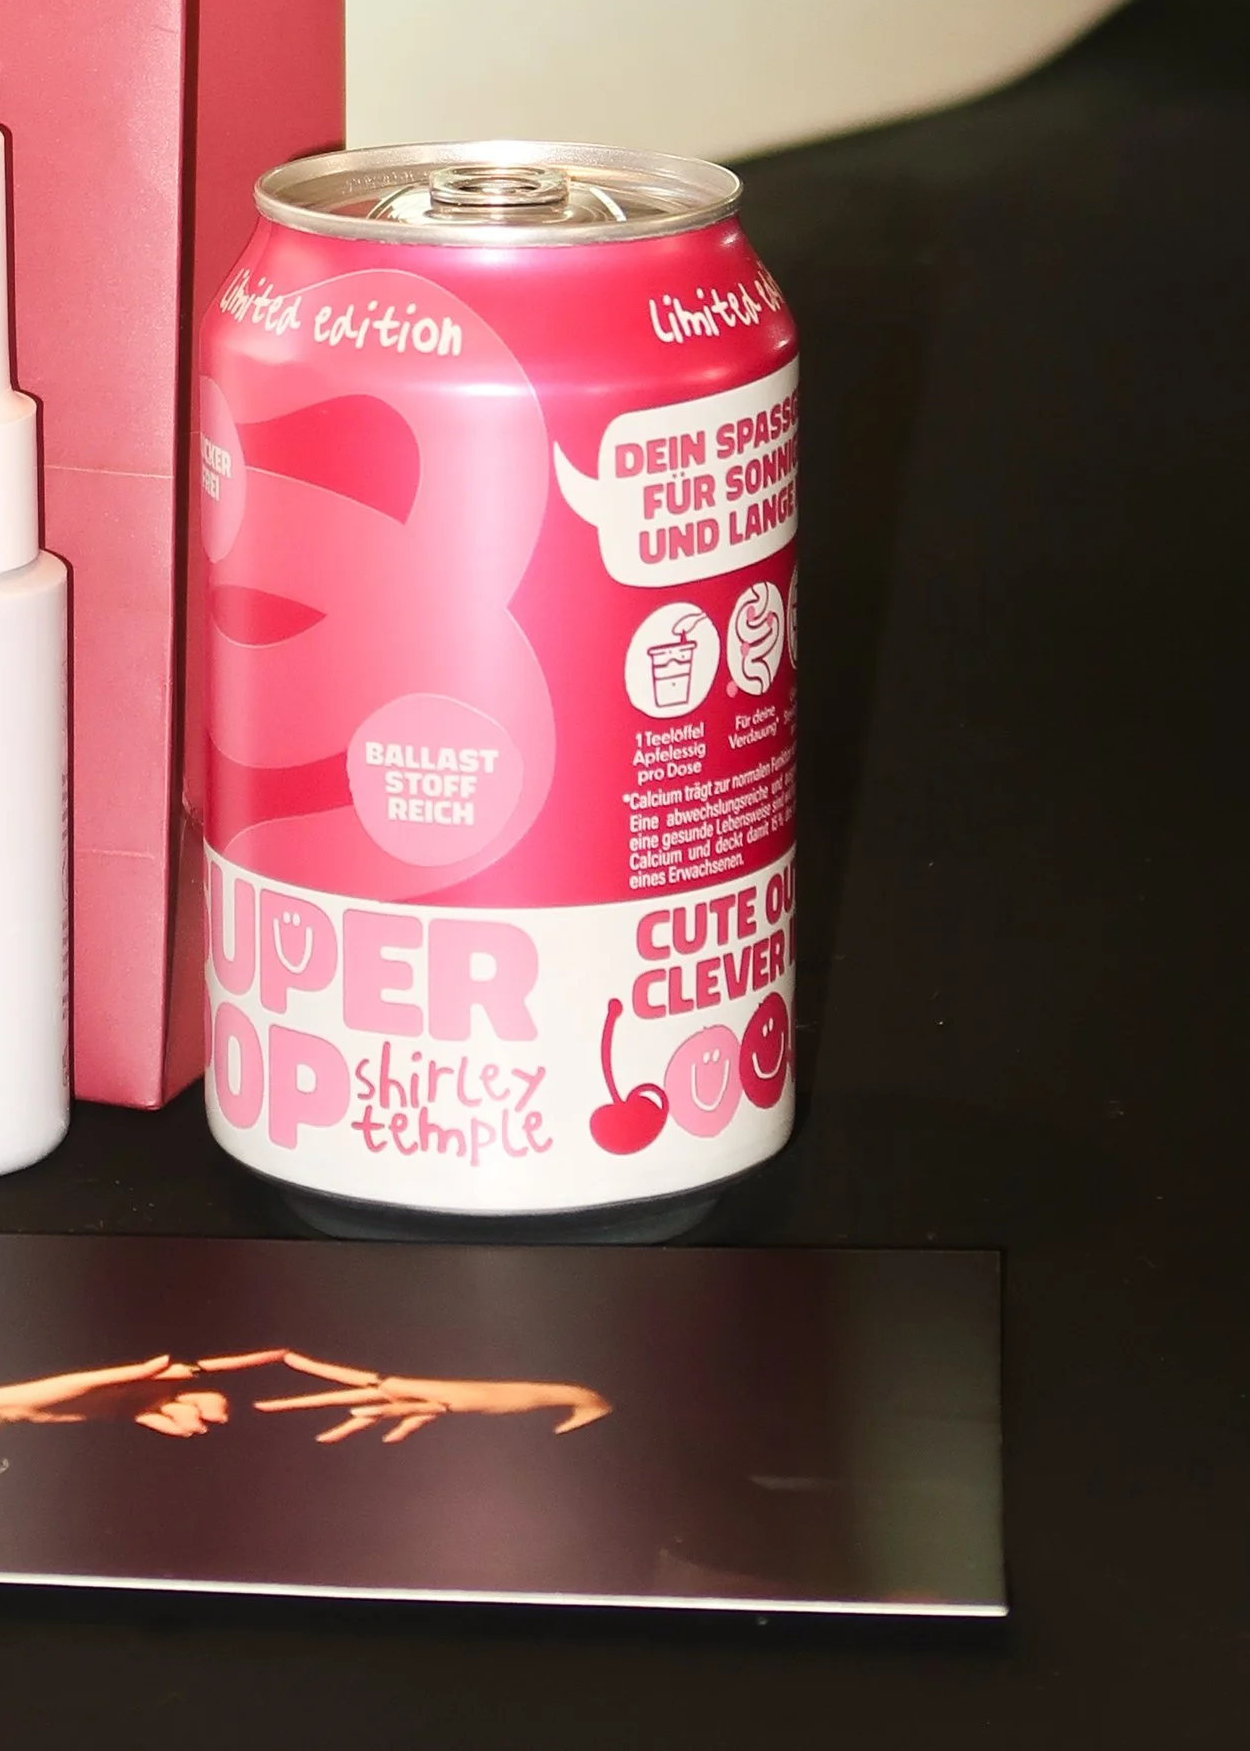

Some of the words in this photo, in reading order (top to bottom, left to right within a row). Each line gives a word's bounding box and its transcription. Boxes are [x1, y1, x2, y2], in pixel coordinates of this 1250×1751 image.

[313, 299, 462, 356] edition
[615, 430, 706, 479] DEIN
[643, 471, 716, 520] FÜR
[639, 518, 720, 565] UND
[635, 733, 642, 748] 1
[645, 721, 705, 748] Teelöffel
[735, 714, 751, 731] Für
[365, 741, 499, 774] BALLAST
[632, 743, 706, 768] Apfelessig
[637, 768, 664, 786] pro
[667, 761, 702, 779] Dose
[385, 770, 478, 799] STOFF
[684, 783, 712, 804] trägt
[714, 778, 730, 795] zur
[388, 796, 475, 826] REICH
[630, 814, 659, 833] Eine
[666, 786, 768, 828] abwechslungsreiche
[630, 835, 659, 852] eine
[662, 823, 713, 850] gesunde
[716, 802, 772, 835] Lebensweise
[629, 850, 682, 871] Calcium
[688, 841, 711, 861] und
[715, 832, 744, 854] deckt
[747, 821, 770, 844] damit
[629, 871, 666, 890] eines
[669, 852, 745, 884] Erwachsenen.
[636, 885, 757, 961] CUTE
[206, 860, 540, 1042] UPER
[631, 928, 785, 1020] CLEVER
[205, 983, 351, 1151] OP
[355, 1041, 547, 1113] shirley
[350, 1105, 554, 1169] temple
